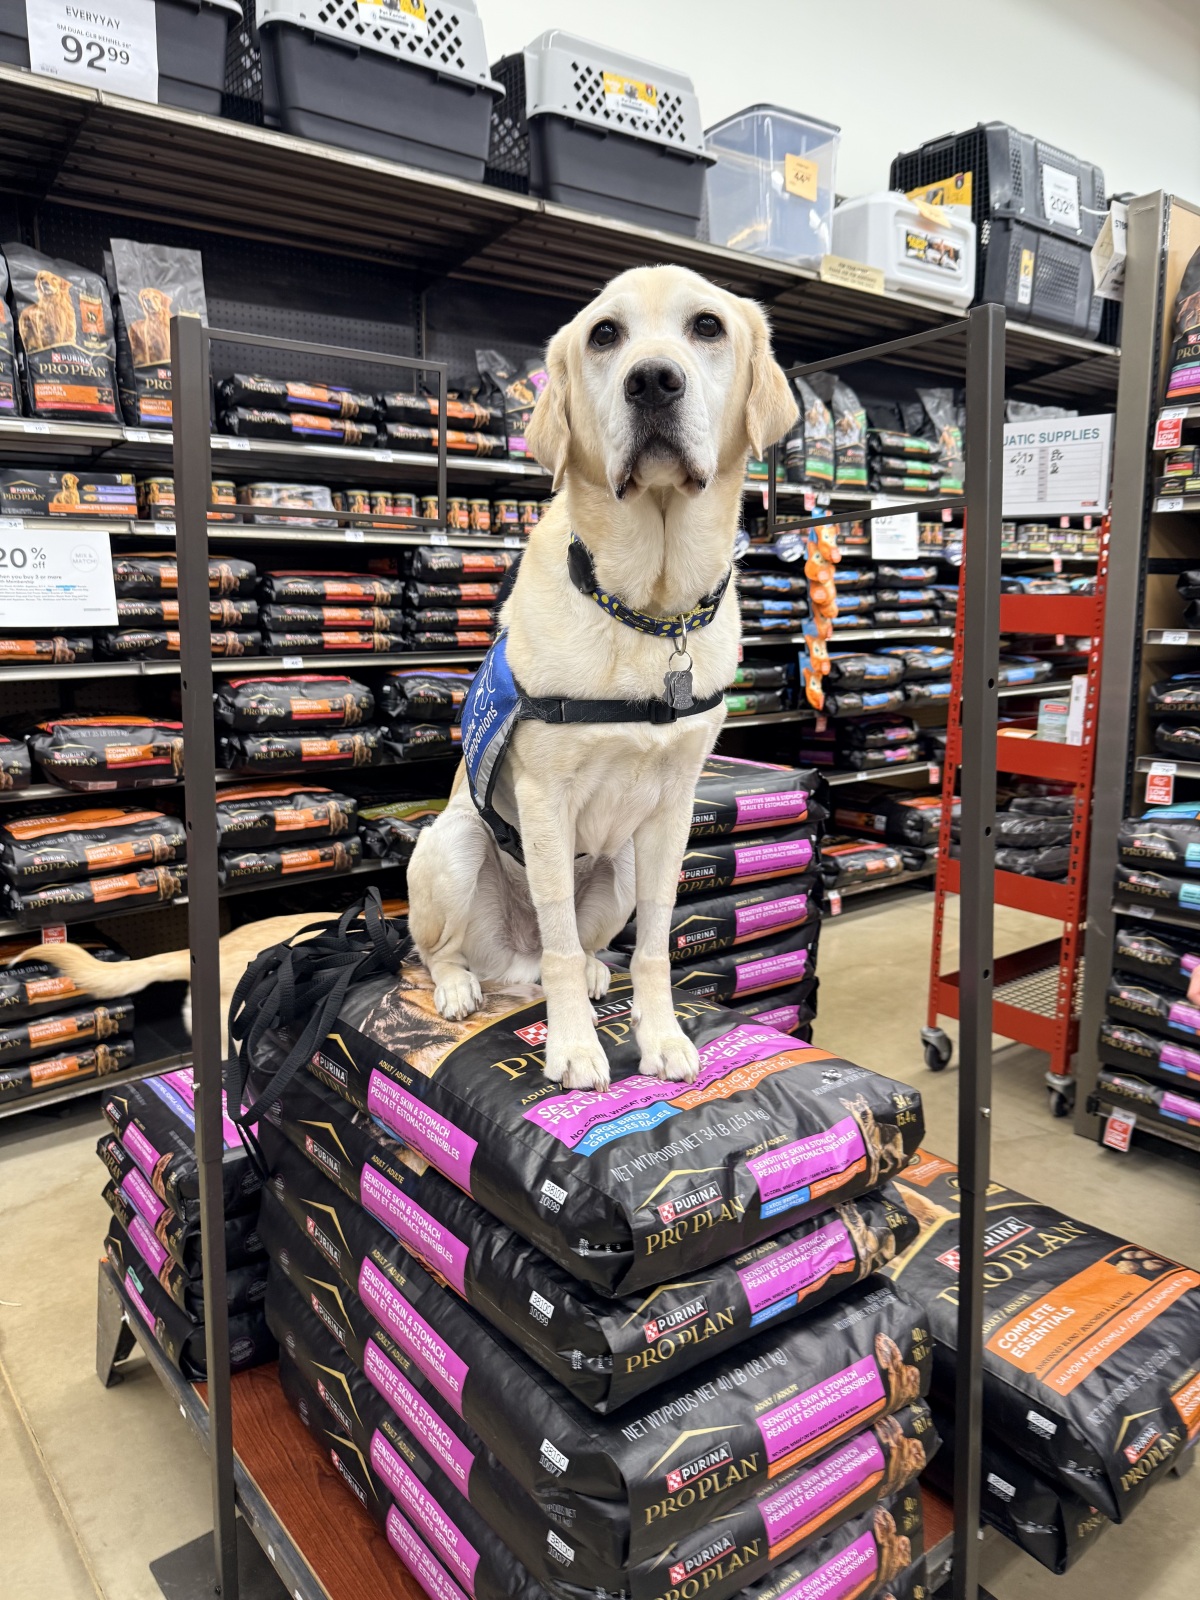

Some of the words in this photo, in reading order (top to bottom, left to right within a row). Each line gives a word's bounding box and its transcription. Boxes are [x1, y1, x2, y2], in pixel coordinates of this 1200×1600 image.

[66, 5, 120, 30] EVERYYAY
[39, 363, 69, 375] PRO
[71, 364, 106, 378] PLAN
[1039, 427, 1100, 442] SUPPLIES
[30, 547, 47, 560] %
[32, 561, 45, 569] off
[68, 757, 98, 766] PLAN
[22, 863, 49, 875] PRO
[50, 860, 79, 873] PLAN
[685, 868, 714, 879] PURINA
[29, 896, 55, 909] PRO
[55, 892, 85, 905] PLAN
[686, 929, 715, 943] PURINA
[596, 1002, 722, 1047] PAN
[698, 1029, 750, 1062] OMACH
[319, 1053, 347, 1083] PURINA
[378, 1058, 393, 1072] ADULT
[395, 1070, 412, 1086] ADULTE
[372, 1075, 400, 1102] SENSITIVE
[399, 1094, 414, 1112] SKIN
[413, 1105, 419, 1115] &
[417, 1108, 451, 1139] STOMACH
[521, 1084, 556, 1106] ADULT
[549, 1094, 608, 1125] PEAUX
[607, 1087, 630, 1100] ET
[370, 1085, 390, 1106] PEAUX
[388, 1099, 396, 1111] ET
[395, 1105, 426, 1135] ESTOMACS
[425, 1127, 460, 1161] SENSIBLES
[570, 1129, 584, 1141] NO
[584, 1113, 611, 1128] CORN,
[609, 1100, 640, 1115] WHEAT
[583, 1122, 619, 1145] LARGE
[617, 1112, 650, 1127] BREED
[589, 1119, 640, 1147] GRANDES
[640, 1109, 671, 1127] RACES
[610, 1162, 634, 1183] NET
[631, 1141, 684, 1172] WT/POIDS
[679, 1131, 704, 1152] NET
[701, 1125, 718, 1141] 34
[715, 1121, 731, 1138] LB
[728, 1110, 756, 1133] (15.4
[752, 1103, 771, 1124] kg)
[753, 1151, 789, 1171] SENSITIVE
[788, 1144, 805, 1157] SKIN
[758, 1163, 782, 1179] PEAUX
[781, 1159, 792, 1168] ET
[791, 1145, 824, 1165] ESTOMACS
[539, 1194, 561, 1214] 10099
[674, 1186, 719, 1213] PURINA
[645, 1220, 688, 1256] PRO
[691, 1195, 745, 1234] PLAN
[983, 1218, 1025, 1250] RINA
[1000, 1220, 1088, 1271] PLAN
[657, 1301, 706, 1331] PURINA
[997, 1302, 1057, 1350] COMPLETE
[1010, 1305, 1077, 1359] ESSENTIALS
[625, 1338, 676, 1374] PRO
[676, 1307, 735, 1350] PLAN
[1055, 1359, 1084, 1386] SALMON
[1086, 1344, 1102, 1360] RICE
[620, 1419, 650, 1442] NET
[643, 1392, 700, 1430] WT/POIDS
[693, 1381, 719, 1405] NET
[715, 1374, 733, 1393] 40
[729, 1366, 748, 1387] LB
[744, 1353, 771, 1379] (18.1
[768, 1344, 789, 1369] kg)
[682, 1447, 729, 1480] PURINA
[644, 1489, 696, 1526] PRO
[697, 1452, 759, 1507] PLAN
